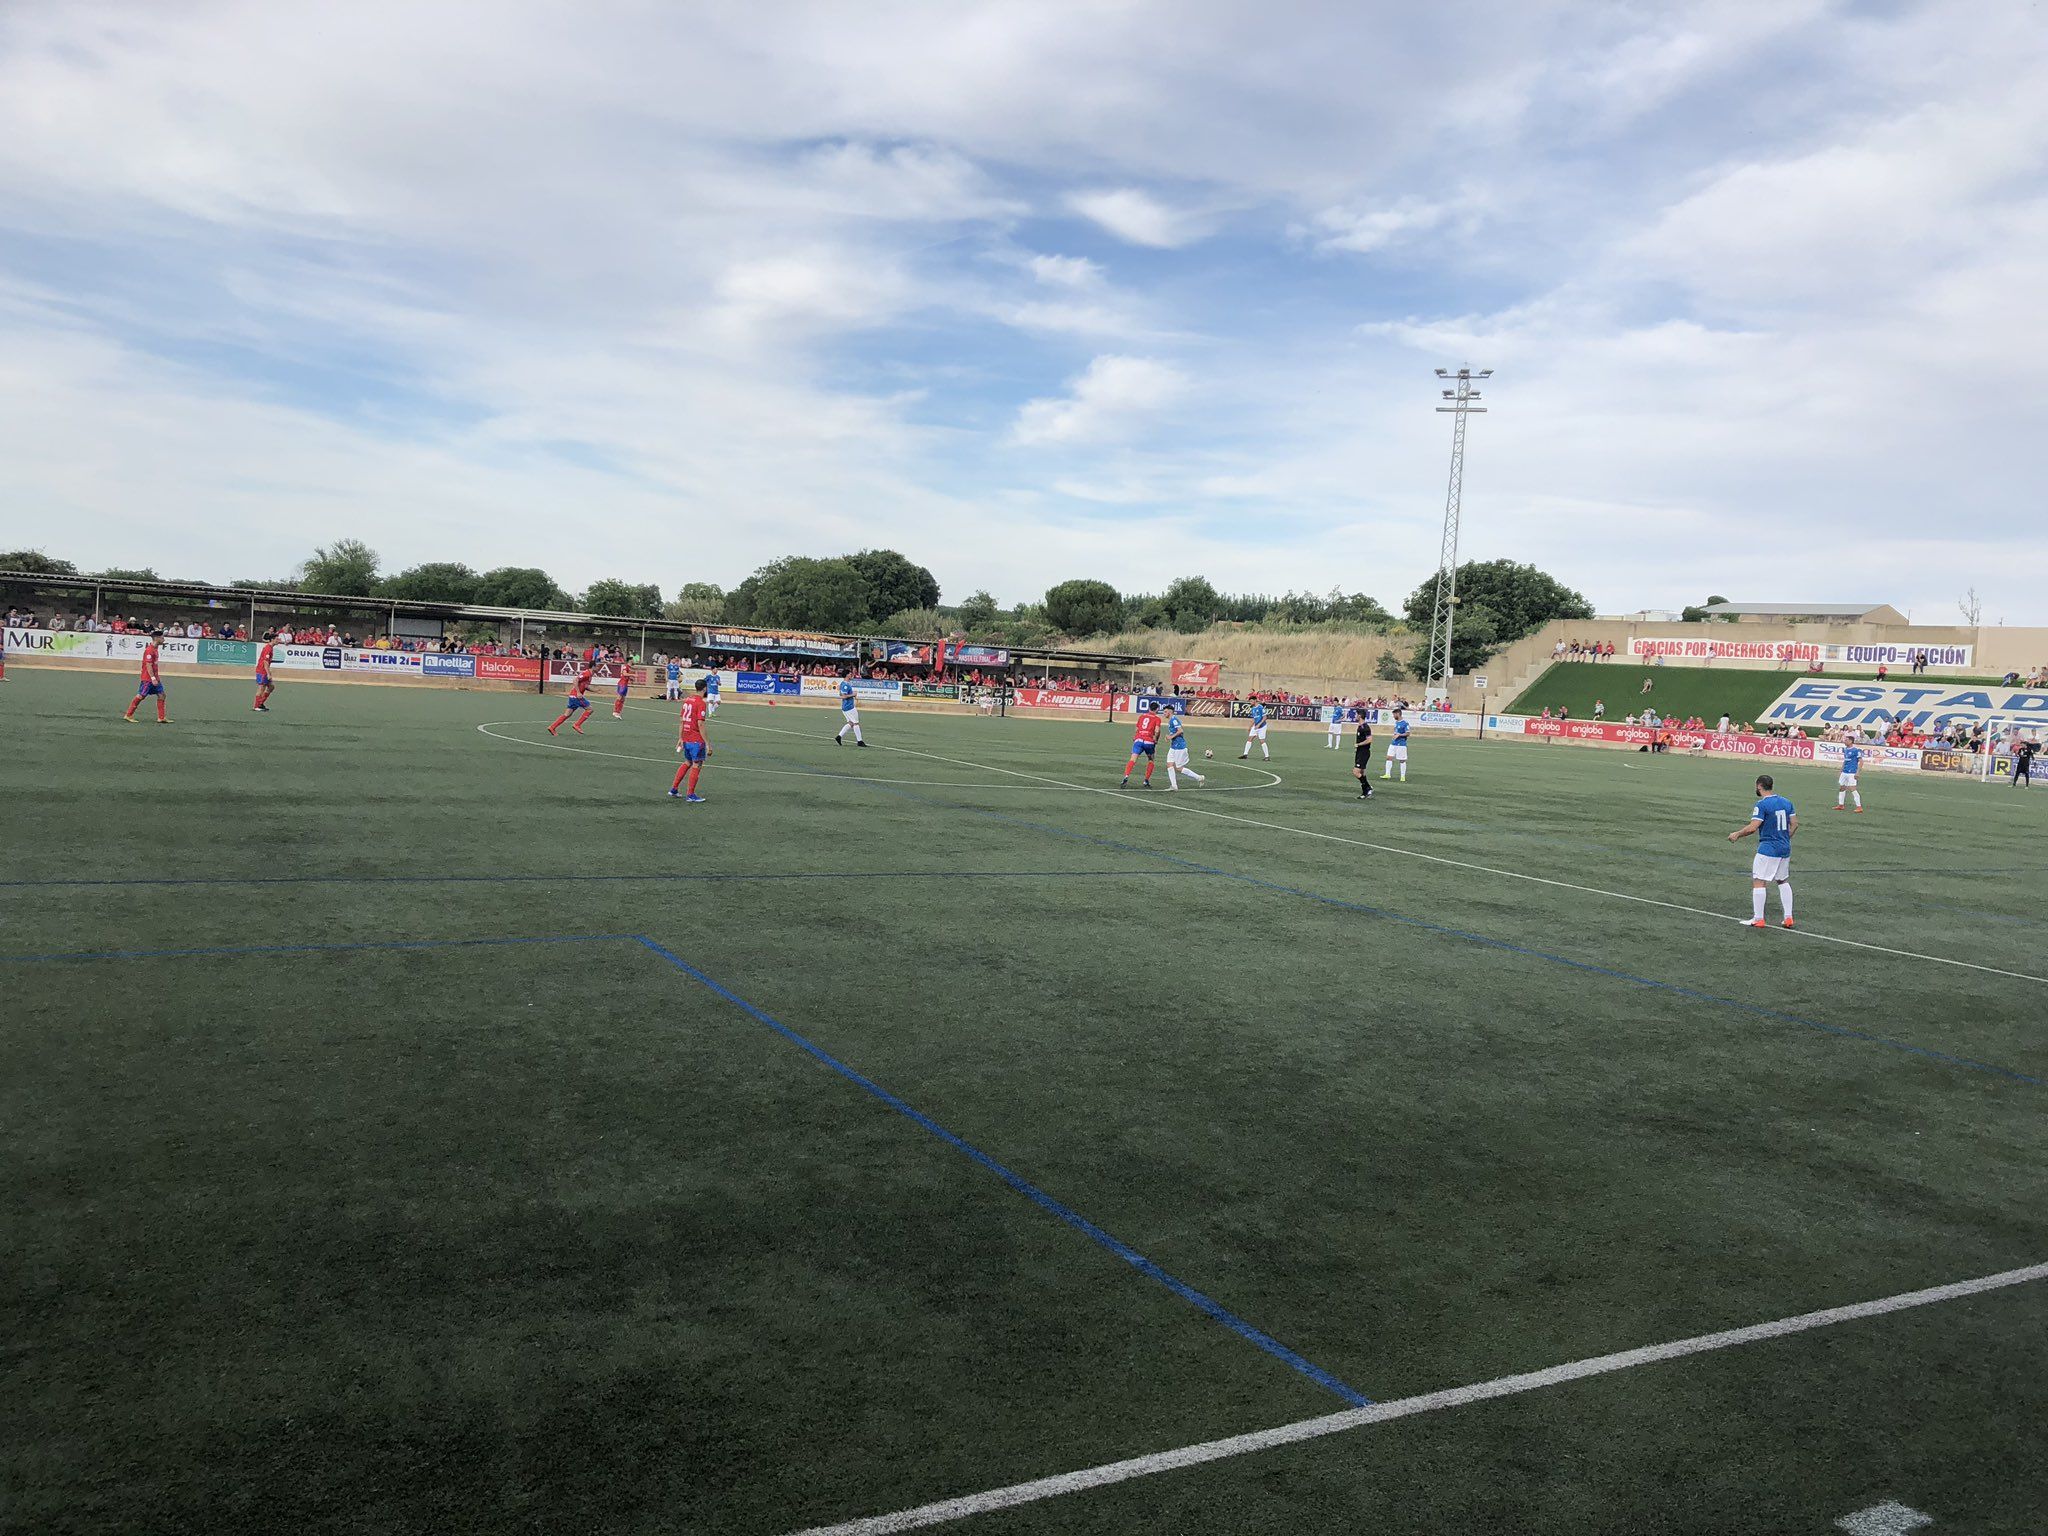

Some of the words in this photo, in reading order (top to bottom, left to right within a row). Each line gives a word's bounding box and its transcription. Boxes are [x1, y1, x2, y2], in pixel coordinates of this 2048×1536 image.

[1634, 640, 1683, 656] GRACIAS
[1685, 641, 1707, 656] POR
[1709, 641, 1774, 658] HACERNOS
[1776, 641, 1820, 660] SOÑAR
[371, 655, 397, 665] TIEN
[481, 660, 515, 673] Halcón
[682, 703, 693, 721] 22
[1142, 717, 1150, 729] 9
[1530, 721, 1560, 733] engloba
[1572, 725, 1603, 737] engloba
[1710, 740, 1756, 754] CASINO
[1763, 743, 1812, 758] CASINO
[1819, 743, 1880, 758] Sango
[1885, 748, 1918, 760] Sola
[1775, 809, 1787, 831] 11
